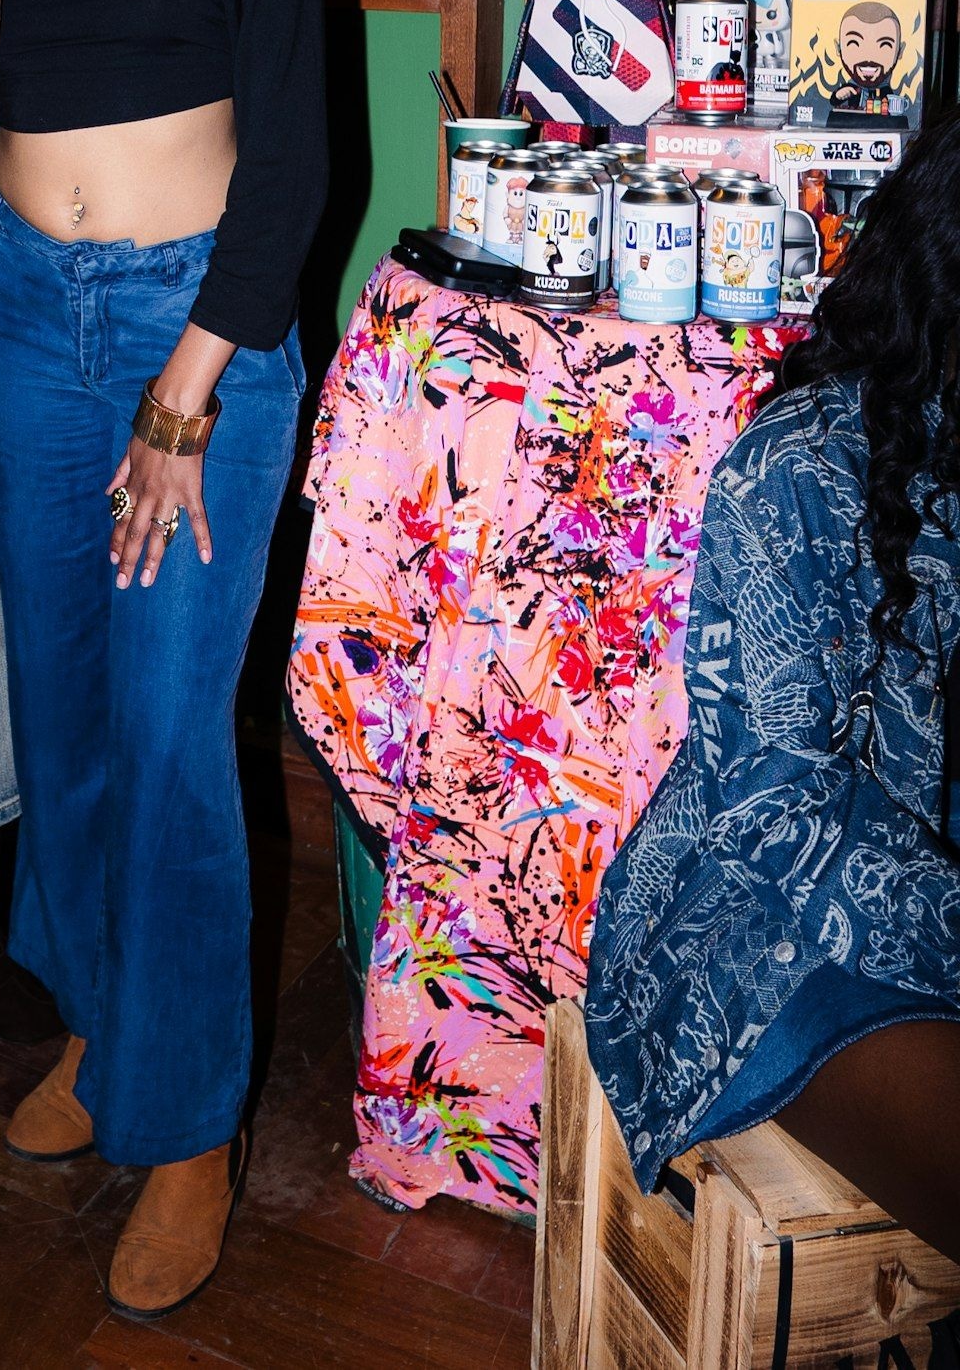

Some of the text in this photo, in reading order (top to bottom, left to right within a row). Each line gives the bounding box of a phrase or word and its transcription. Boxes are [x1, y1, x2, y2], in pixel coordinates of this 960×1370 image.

[702, 16, 748, 46] SOD
[691, 57, 703, 66] DC
[699, 84, 734, 94] BATMAN
[654, 135, 722, 155] BORED
[774, 142, 816, 162] POP!
[822, 142, 863, 151] STAR
[871, 143, 891, 159] 402
[822, 150, 863, 160] WARS
[450, 170, 484, 198] SOD
[527, 204, 586, 238] SODA
[712, 215, 775, 250] SODA
[534, 275, 570, 291] KUZCO
[623, 288, 663, 303] FROZONE
[717, 288, 765, 304] RUSSELL
